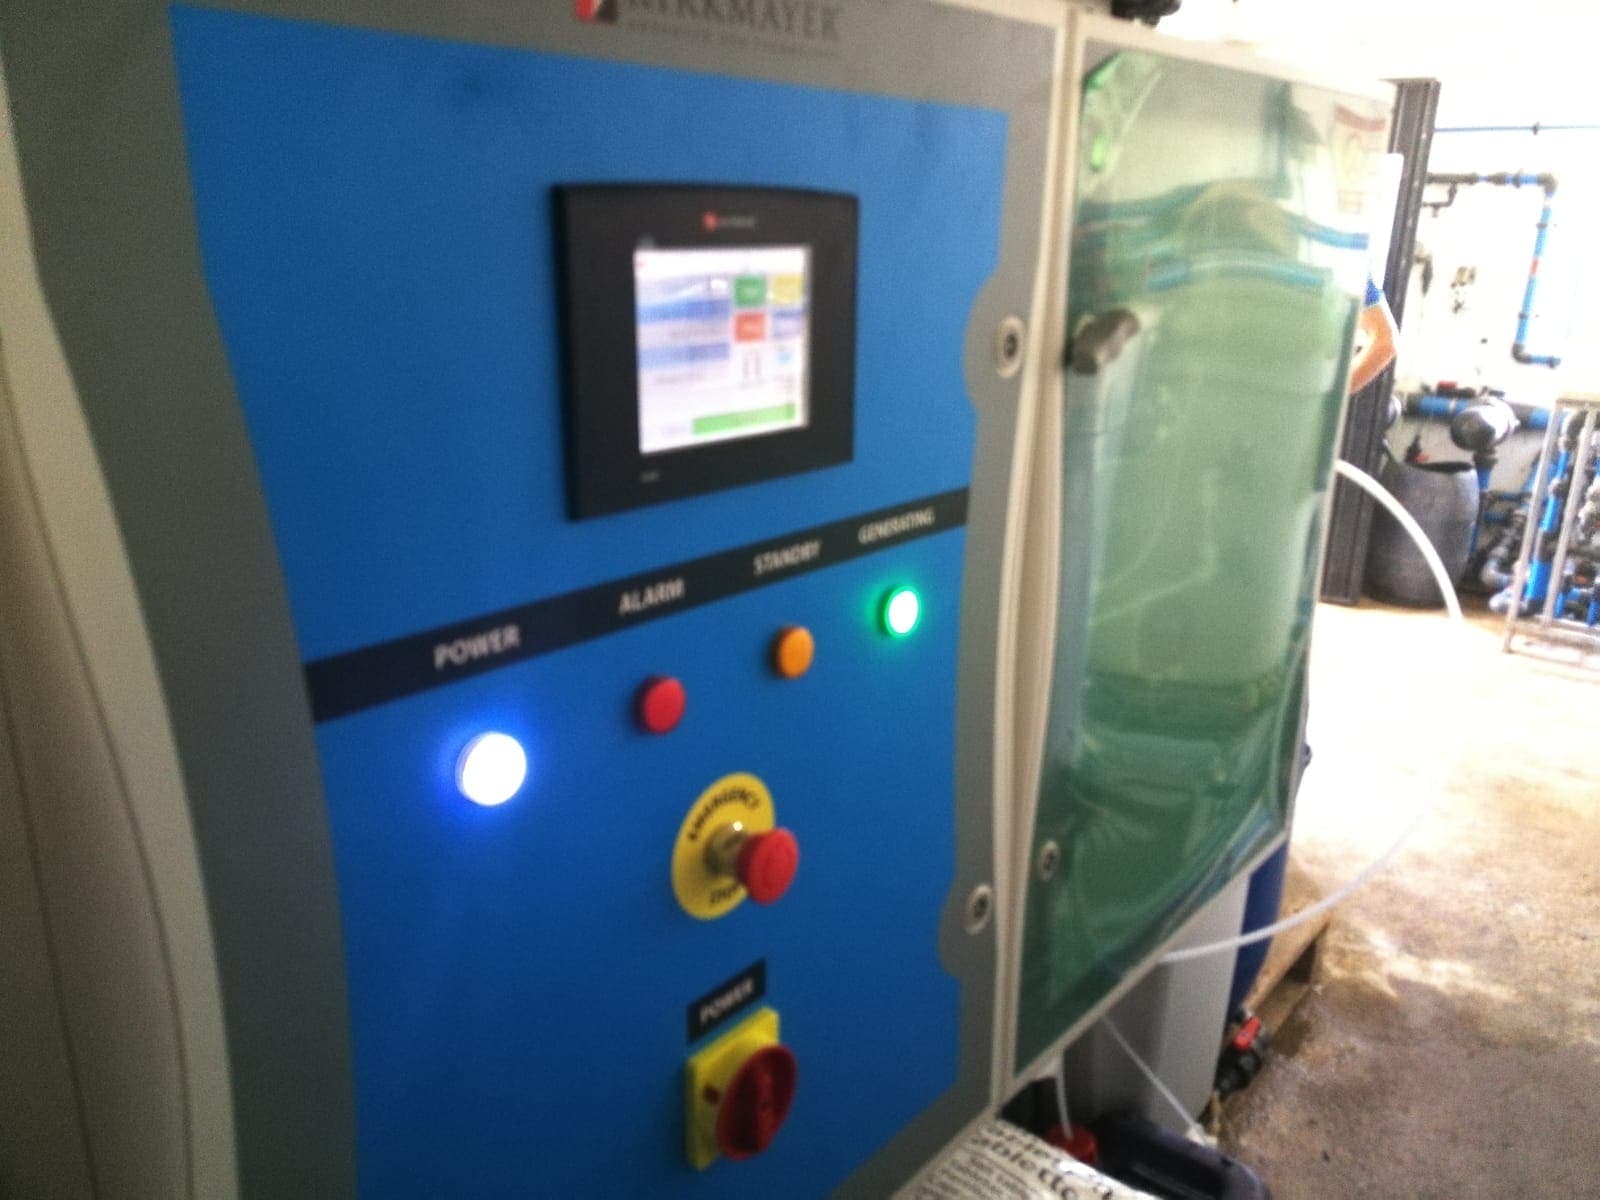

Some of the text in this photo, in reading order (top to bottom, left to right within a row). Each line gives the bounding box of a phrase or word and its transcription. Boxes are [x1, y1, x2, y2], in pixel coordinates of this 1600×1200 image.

[857, 507, 936, 545] GENERATING
[753, 540, 822, 575] STANDBY
[618, 577, 686, 615] ALARM
[433, 624, 521, 671] POWER
[699, 977, 755, 1023] POWER
